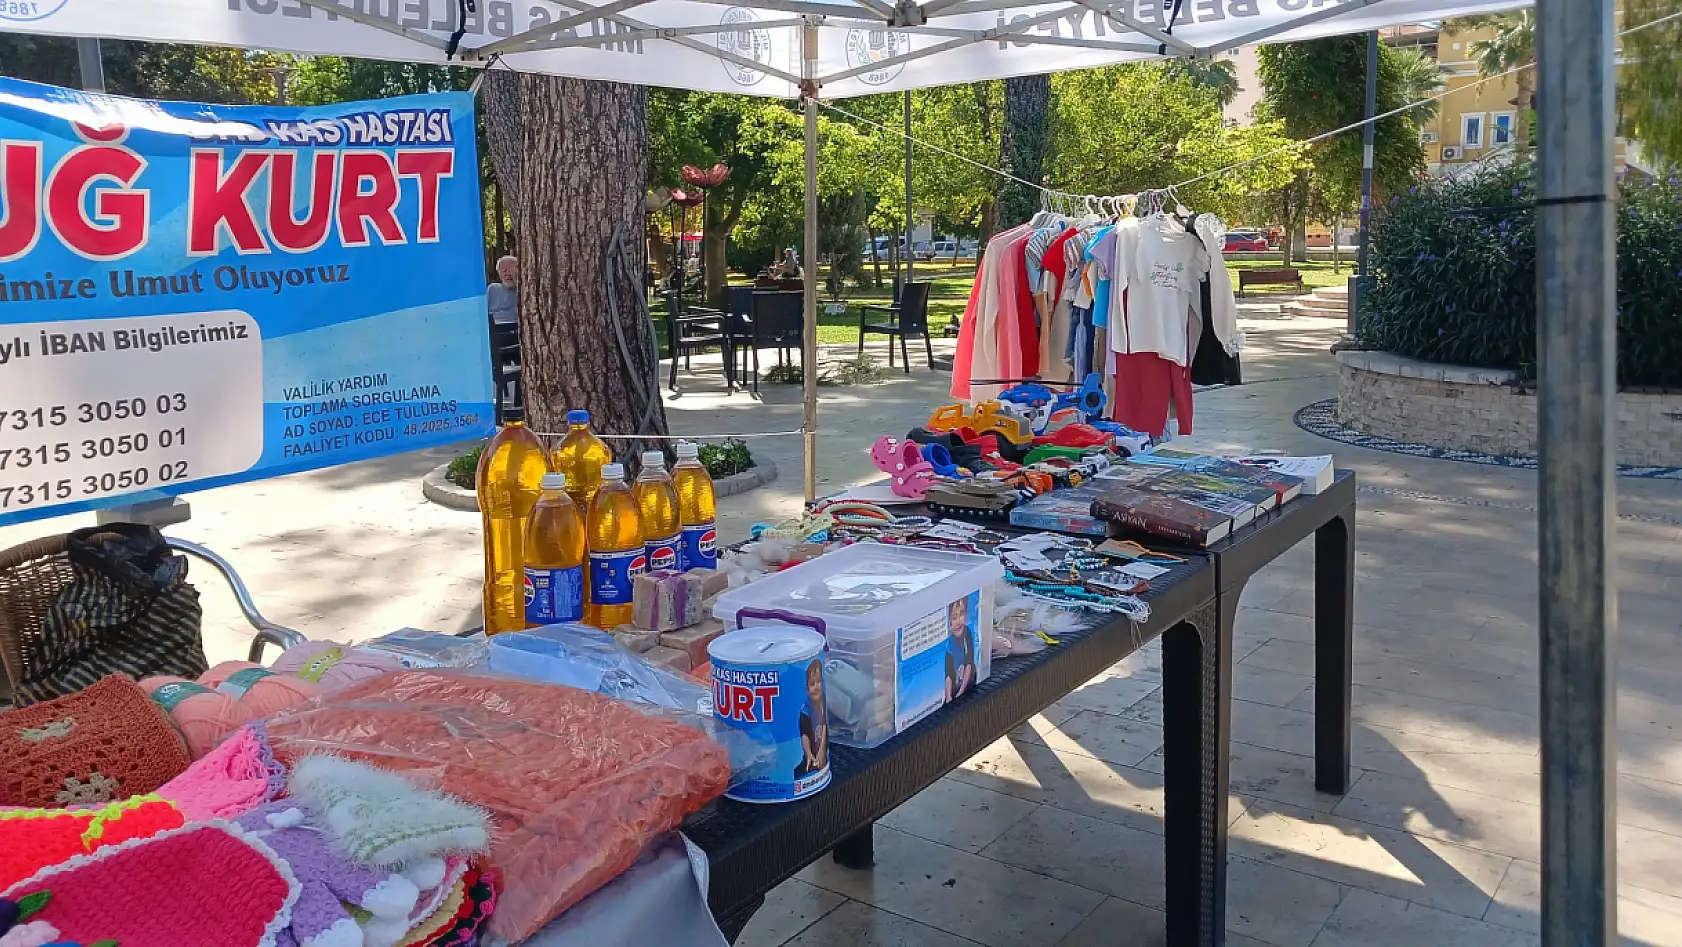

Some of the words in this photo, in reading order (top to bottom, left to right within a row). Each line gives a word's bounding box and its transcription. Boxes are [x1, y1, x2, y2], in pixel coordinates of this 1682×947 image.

[342, 112, 453, 143] HASTASI
[187, 148, 454, 257] KURT
[109, 269, 204, 298] Umut
[214, 263, 351, 294] Oluyoruz
[40, 329, 106, 356] İBAN
[113, 321, 249, 353] Bilgilerimiz
[283, 379, 335, 402] VALİLİK
[337, 373, 389, 391] YARDIM
[283, 401, 349, 421] TOPLAMA
[352, 384, 442, 409] SORGULAMA
[78, 399, 147, 423] 3050
[156, 392, 188, 414] 03
[283, 423, 305, 440] AD
[309, 416, 359, 436] SOYAD:
[363, 408, 391, 424] ECE
[395, 399, 458, 420] TÜLÜBAŞ
[0, 442, 71, 470] 7315
[81, 432, 149, 459] 3050
[158, 427, 187, 448] 01
[283, 433, 351, 459] FAALİYET
[354, 426, 399, 445] KODU:
[0, 478, 72, 509] 7315
[82, 467, 149, 495] 3050
[158, 460, 189, 482] 02
[733, 670, 779, 685] HASTASI
[711, 679, 780, 723] URT
